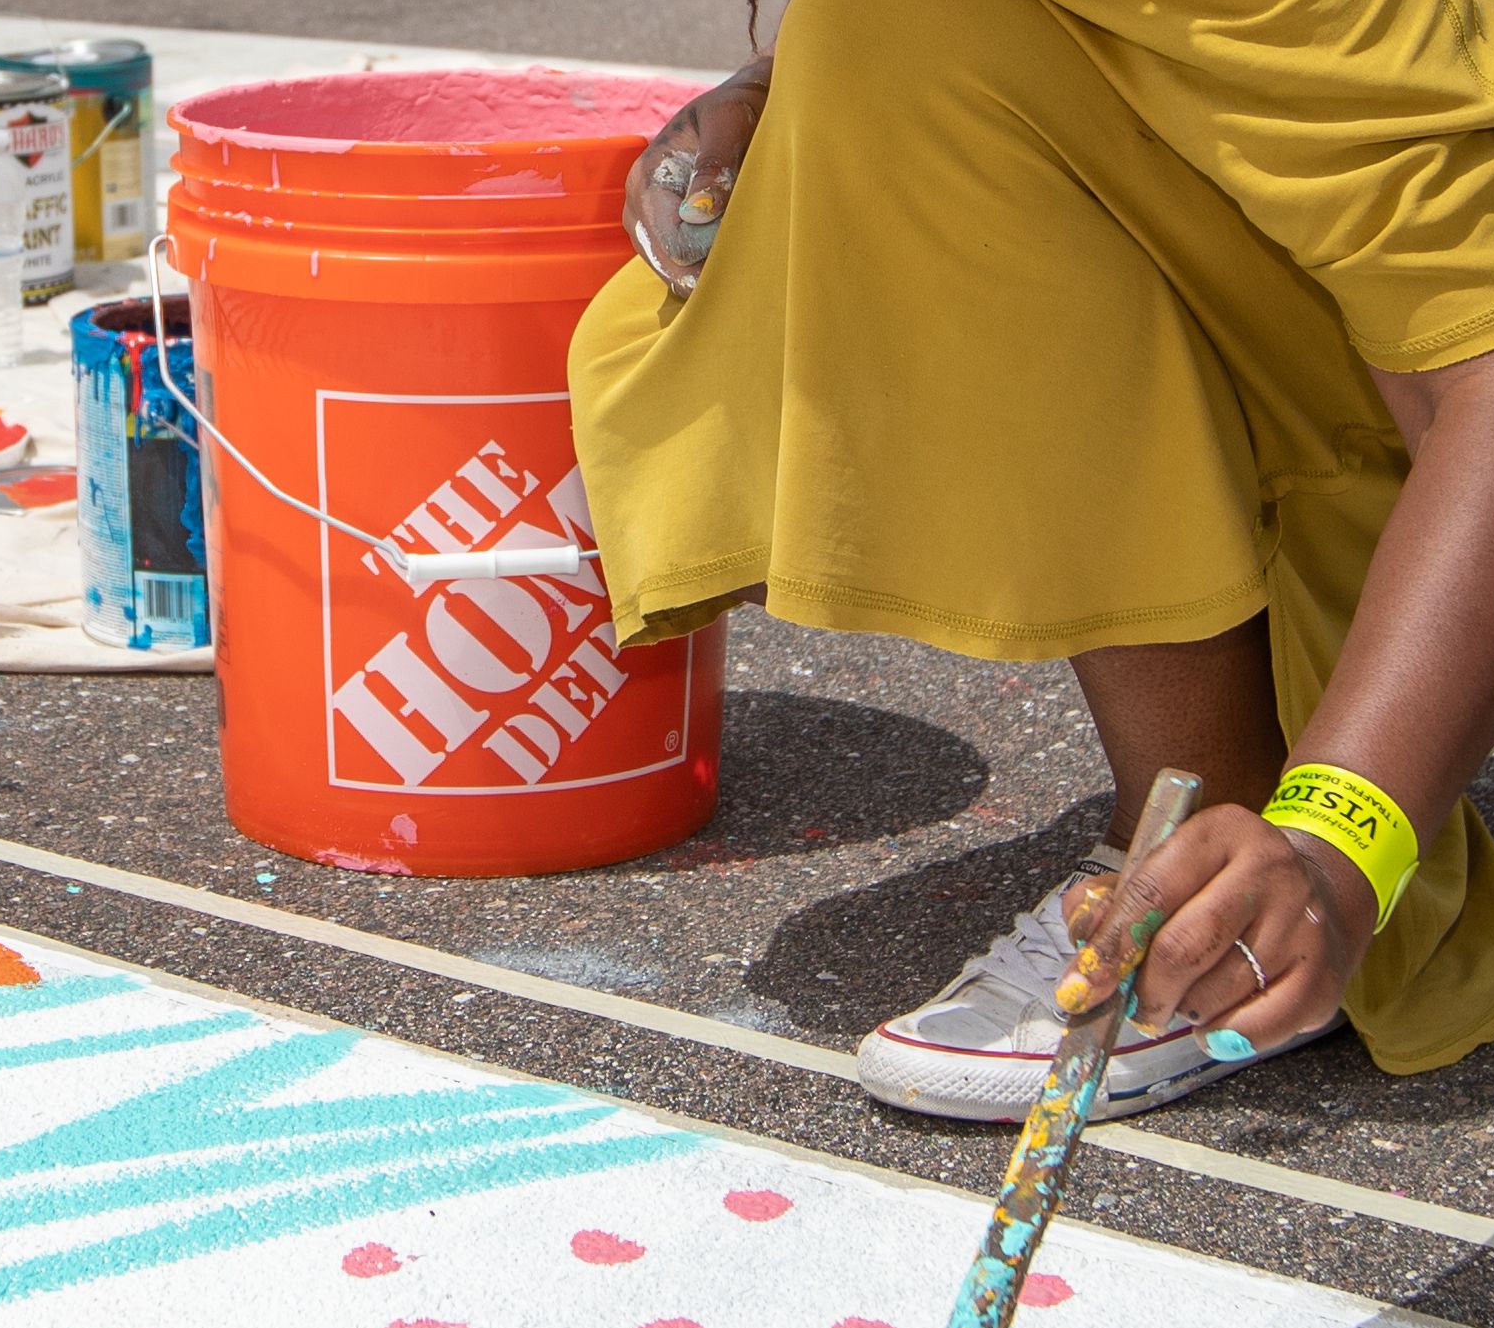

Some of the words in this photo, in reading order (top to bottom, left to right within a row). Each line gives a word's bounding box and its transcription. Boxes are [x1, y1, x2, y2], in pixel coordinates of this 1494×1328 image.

[22, 254, 52, 270] HITE
[361, 439, 541, 599] THE
[331, 462, 607, 786] HOM
[482, 621, 629, 786] DEP
[1299, 772, 1341, 786] DEATH
[1343, 781, 1392, 823] TRAFFIC
